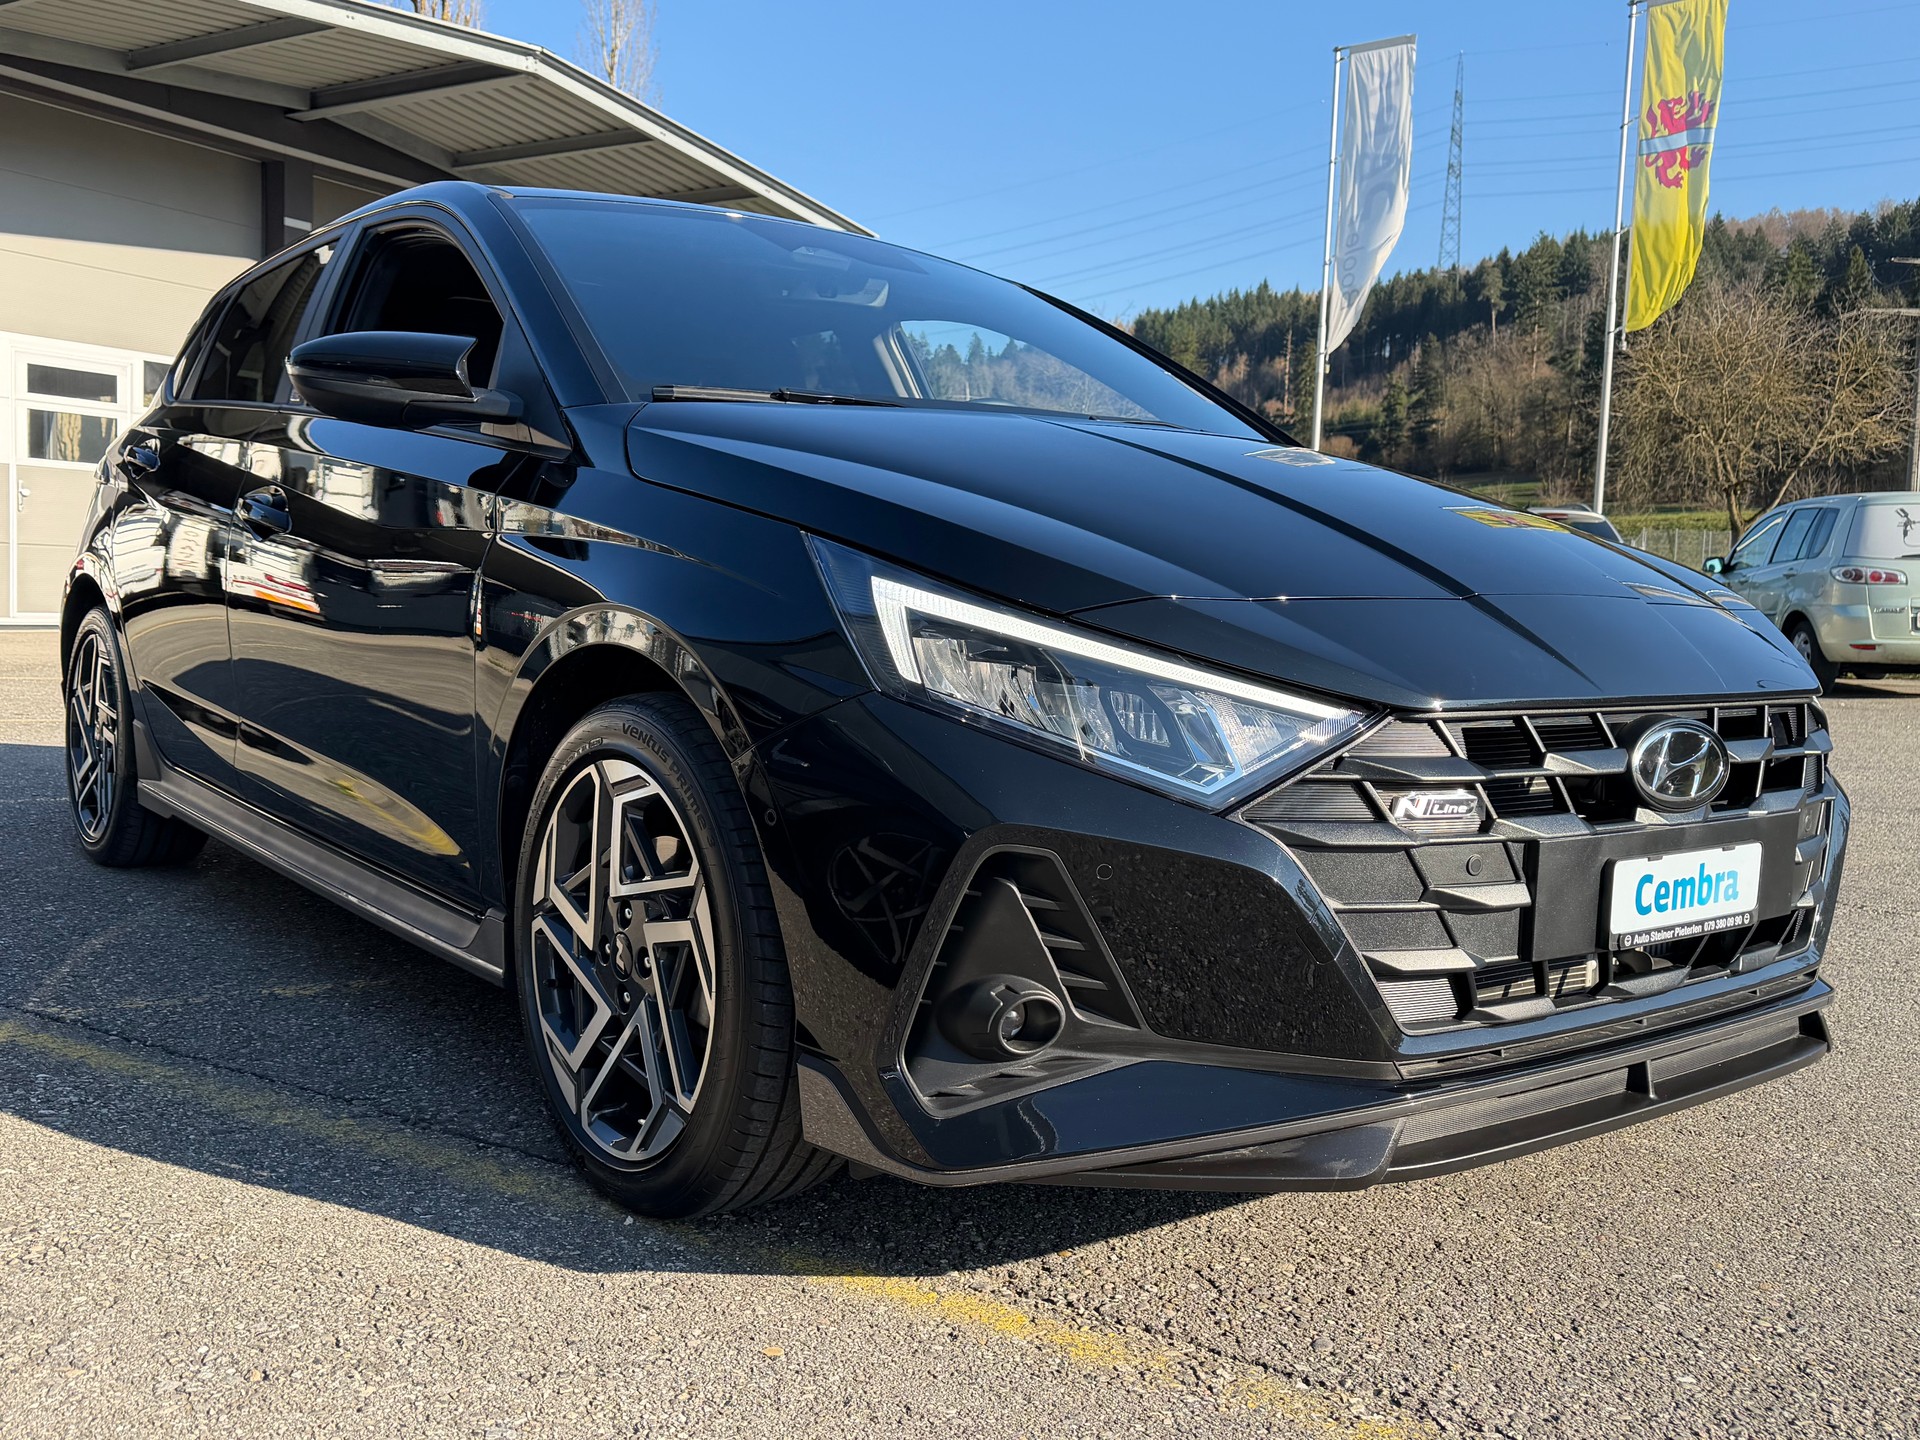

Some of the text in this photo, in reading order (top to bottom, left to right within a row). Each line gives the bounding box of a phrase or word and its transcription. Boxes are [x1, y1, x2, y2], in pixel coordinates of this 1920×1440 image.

[1635, 863, 1739, 915] Cembra
[1633, 915, 1743, 945] Auto Steiner Pieterlen 079 380 09 90
